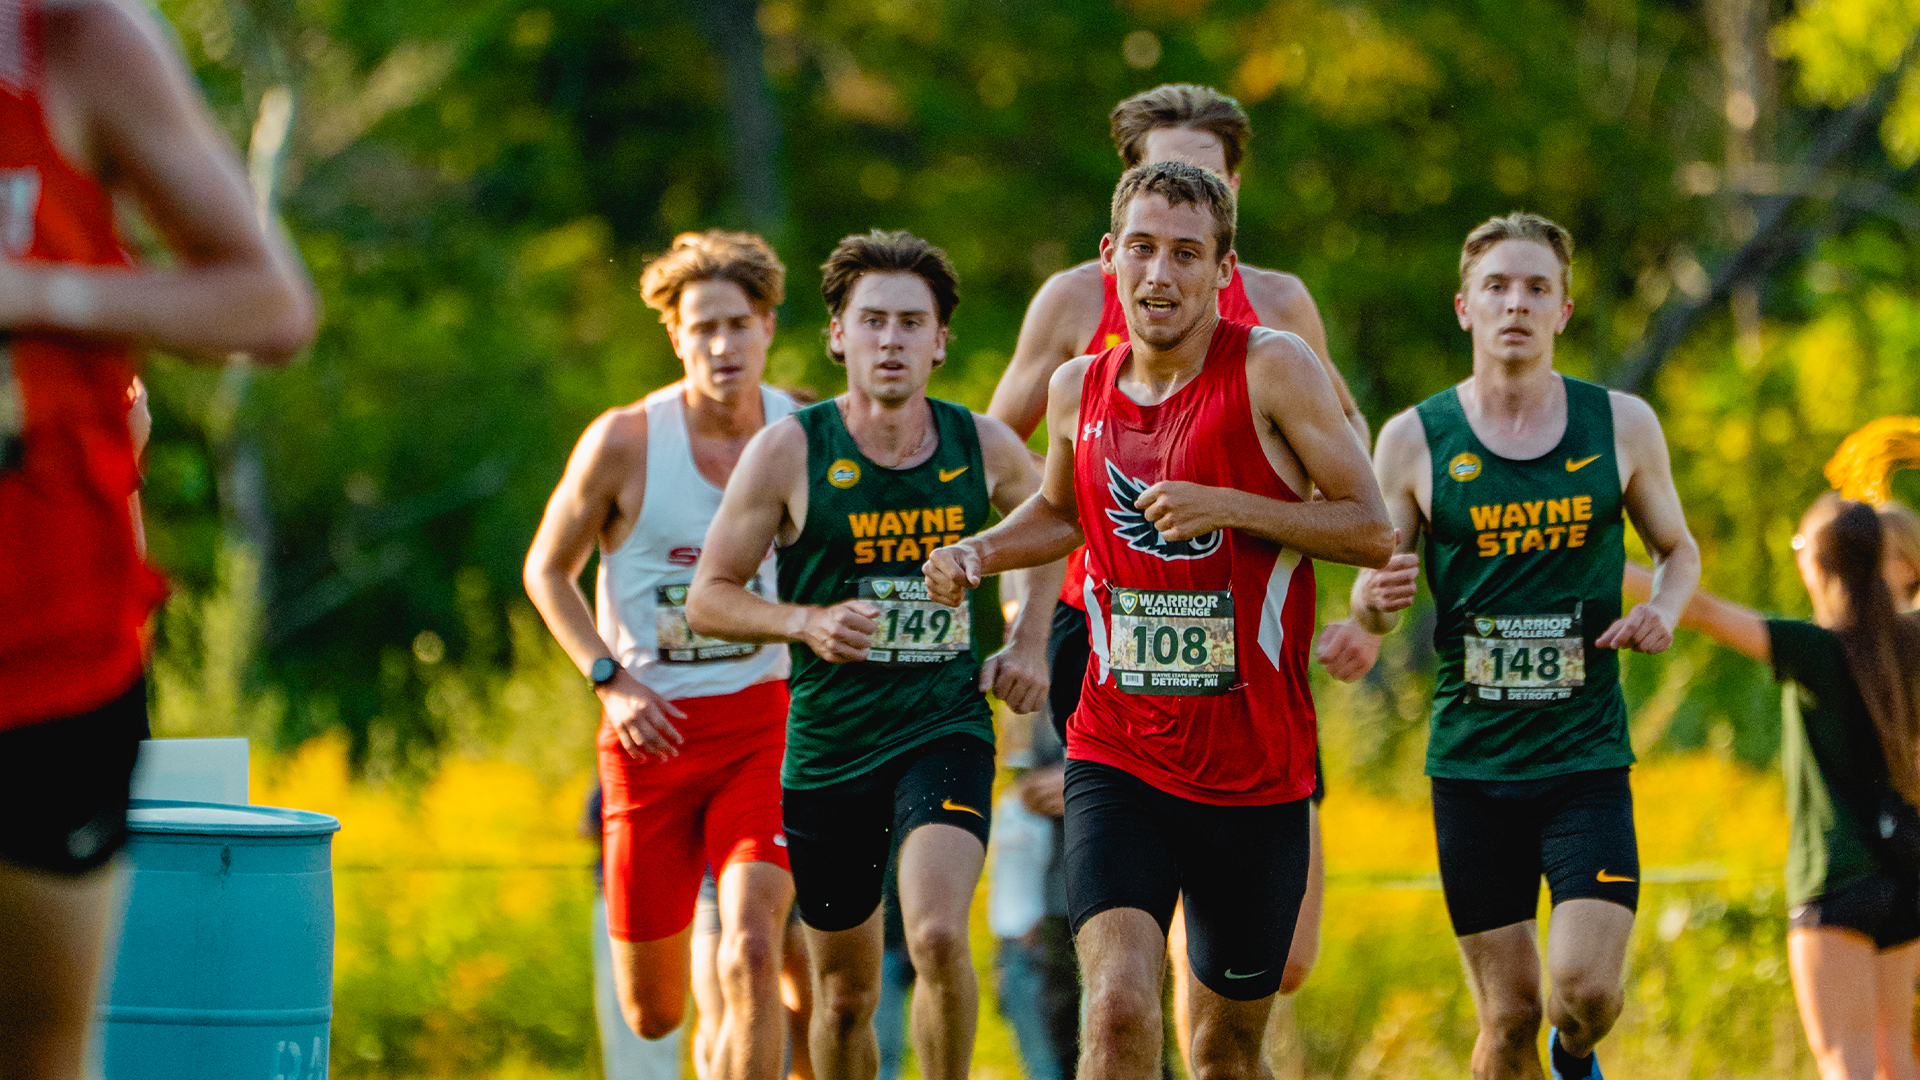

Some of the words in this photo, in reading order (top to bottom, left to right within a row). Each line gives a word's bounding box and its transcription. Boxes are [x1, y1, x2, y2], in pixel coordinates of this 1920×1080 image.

[848, 505, 965, 538] WAYNE
[1470, 495, 1593, 531] WAYNE
[1476, 524, 1588, 557] STATE
[1139, 594, 1219, 608] WARRIOR
[1145, 606, 1211, 617] CHALLENGE
[886, 609, 950, 644] 149
[1496, 618, 1572, 631] WARRIOR
[1502, 629, 1566, 638] CHALLENGE
[1133, 626, 1207, 665] 108
[1490, 646, 1560, 682] 148
[1151, 677, 1202, 688] DETROIT,
[1204, 678, 1218, 687] MI
